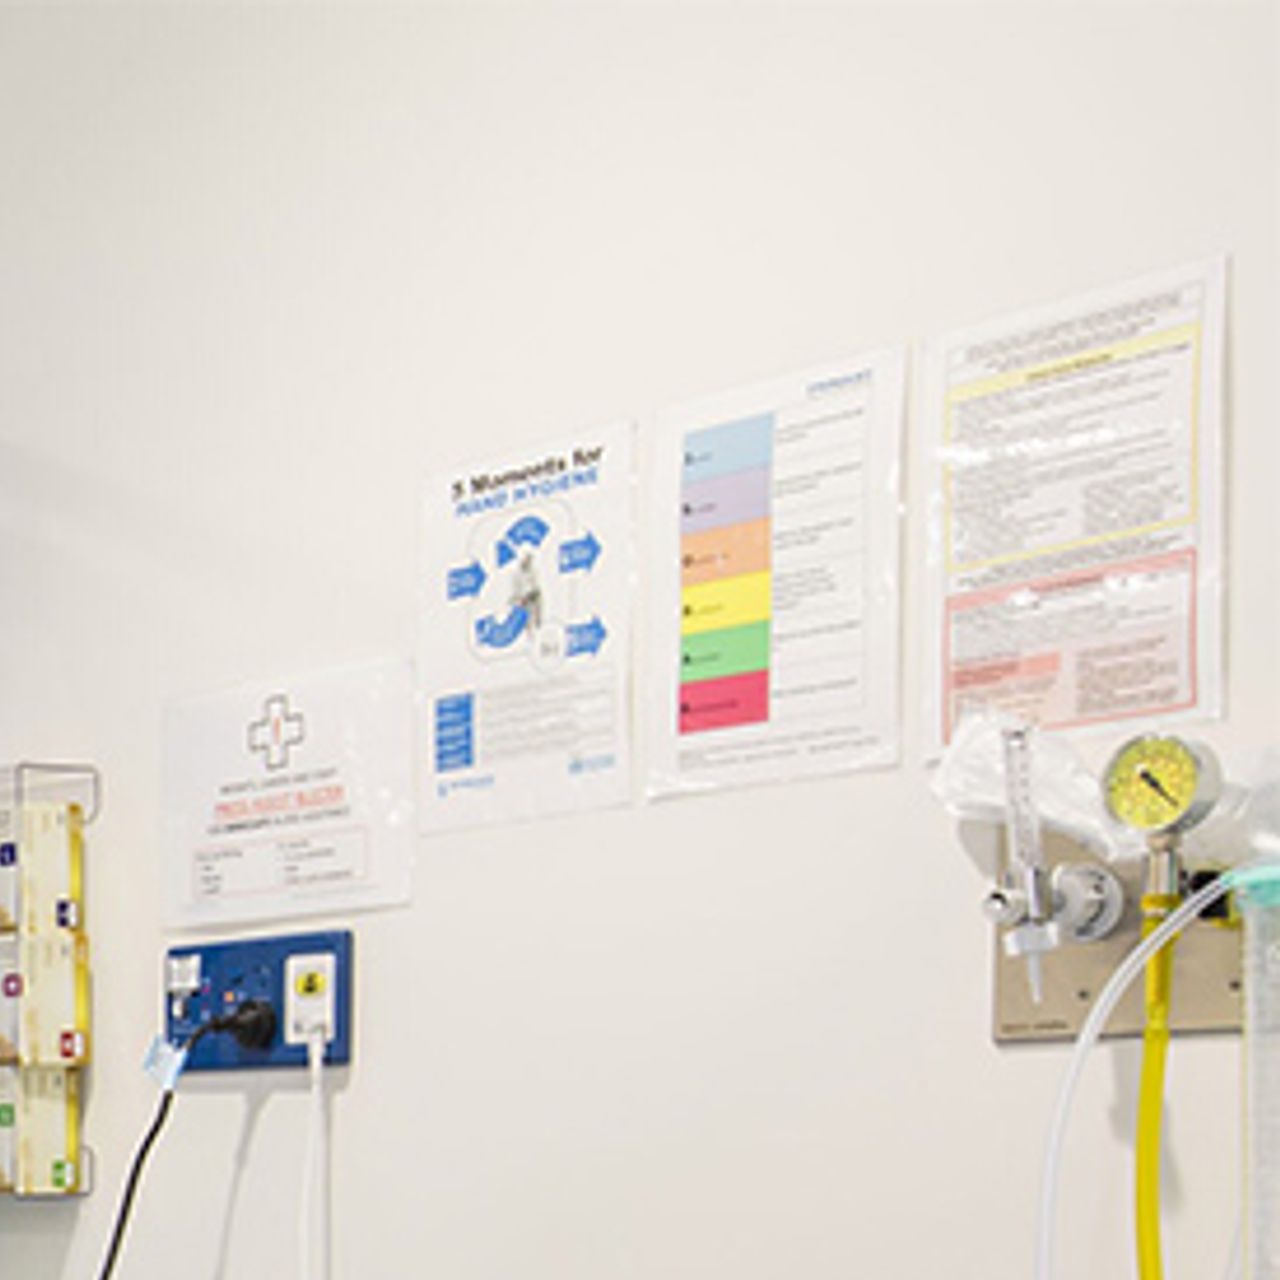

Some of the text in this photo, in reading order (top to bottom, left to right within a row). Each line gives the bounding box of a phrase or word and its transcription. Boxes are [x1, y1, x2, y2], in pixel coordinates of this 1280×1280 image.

[452, 446, 604, 501] 5 Moments for
